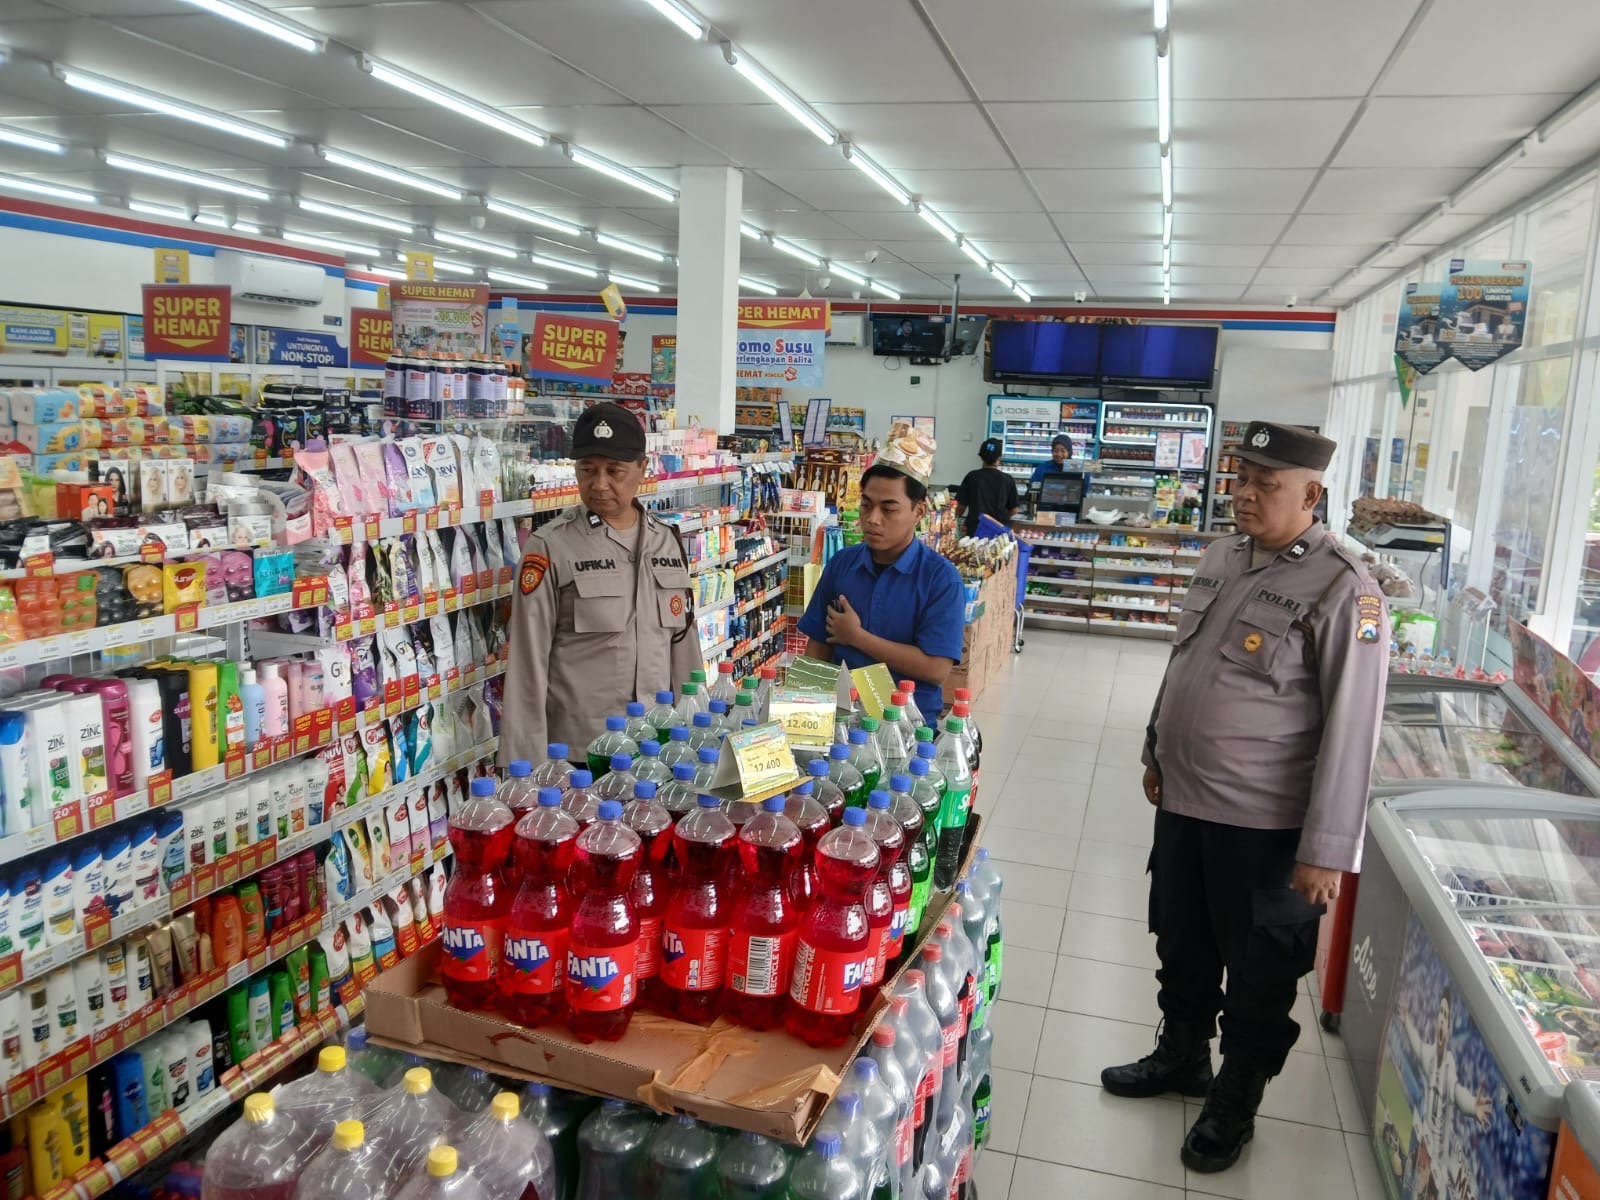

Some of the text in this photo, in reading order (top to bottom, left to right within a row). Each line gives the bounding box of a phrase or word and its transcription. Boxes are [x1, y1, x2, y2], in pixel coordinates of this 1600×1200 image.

[401, 286, 476, 298] SUPER HEMAT
[1457, 287, 1483, 300] 100
[153, 297, 221, 317] SUPER
[767, 306, 822, 320] HEMAT
[153, 318, 222, 338] HEMAT
[544, 324, 608, 348] SUPER
[286, 342, 329, 353] UNTUNGNYA
[542, 341, 606, 363] HEMAT
[775, 338, 813, 354] Susu
[280, 350, 334, 365] NON-STOP!
[788, 356, 812, 364] Balita
[652, 557, 682, 568] POLRI
[1257, 588, 1302, 612] POLRI
[786, 719, 819, 730] 12.400
[444, 926, 486, 949] ANTA
[504, 932, 550, 961] FANTA
[806, 947, 816, 963] ME
[566, 950, 619, 979] FANTA
[770, 937, 780, 994] RECYCLE ME
[800, 964, 814, 1006] RECYCLE
